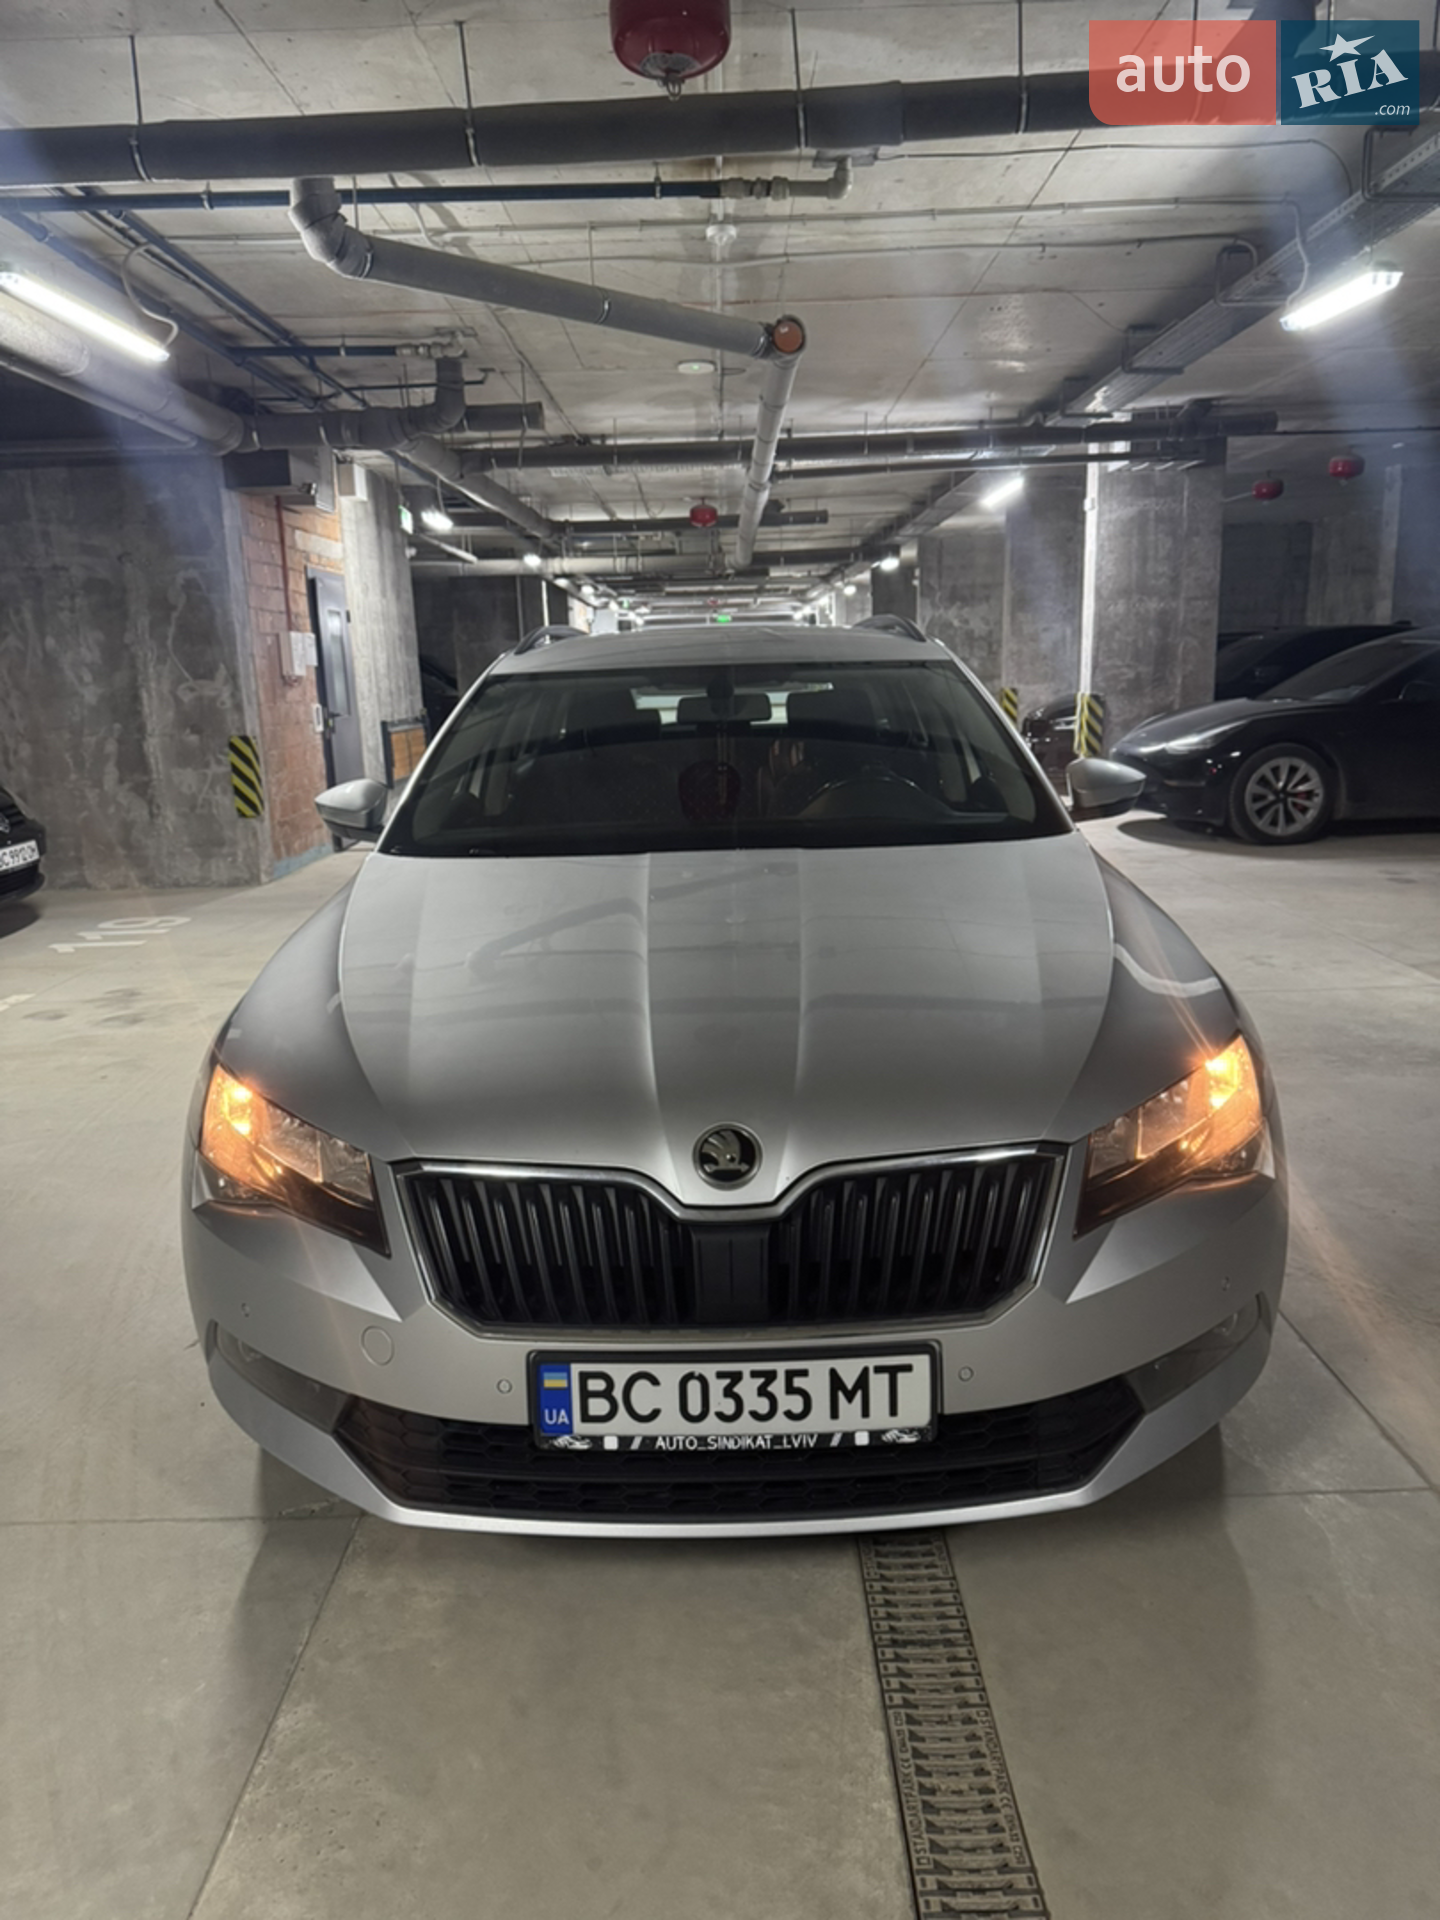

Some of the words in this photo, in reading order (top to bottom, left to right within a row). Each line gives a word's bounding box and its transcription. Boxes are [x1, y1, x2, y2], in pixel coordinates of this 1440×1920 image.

[578, 1370, 662, 1424] BC
[678, 1368, 813, 1424] 0335
[829, 1363, 914, 1420] MT
[544, 1410, 569, 1426] UA
